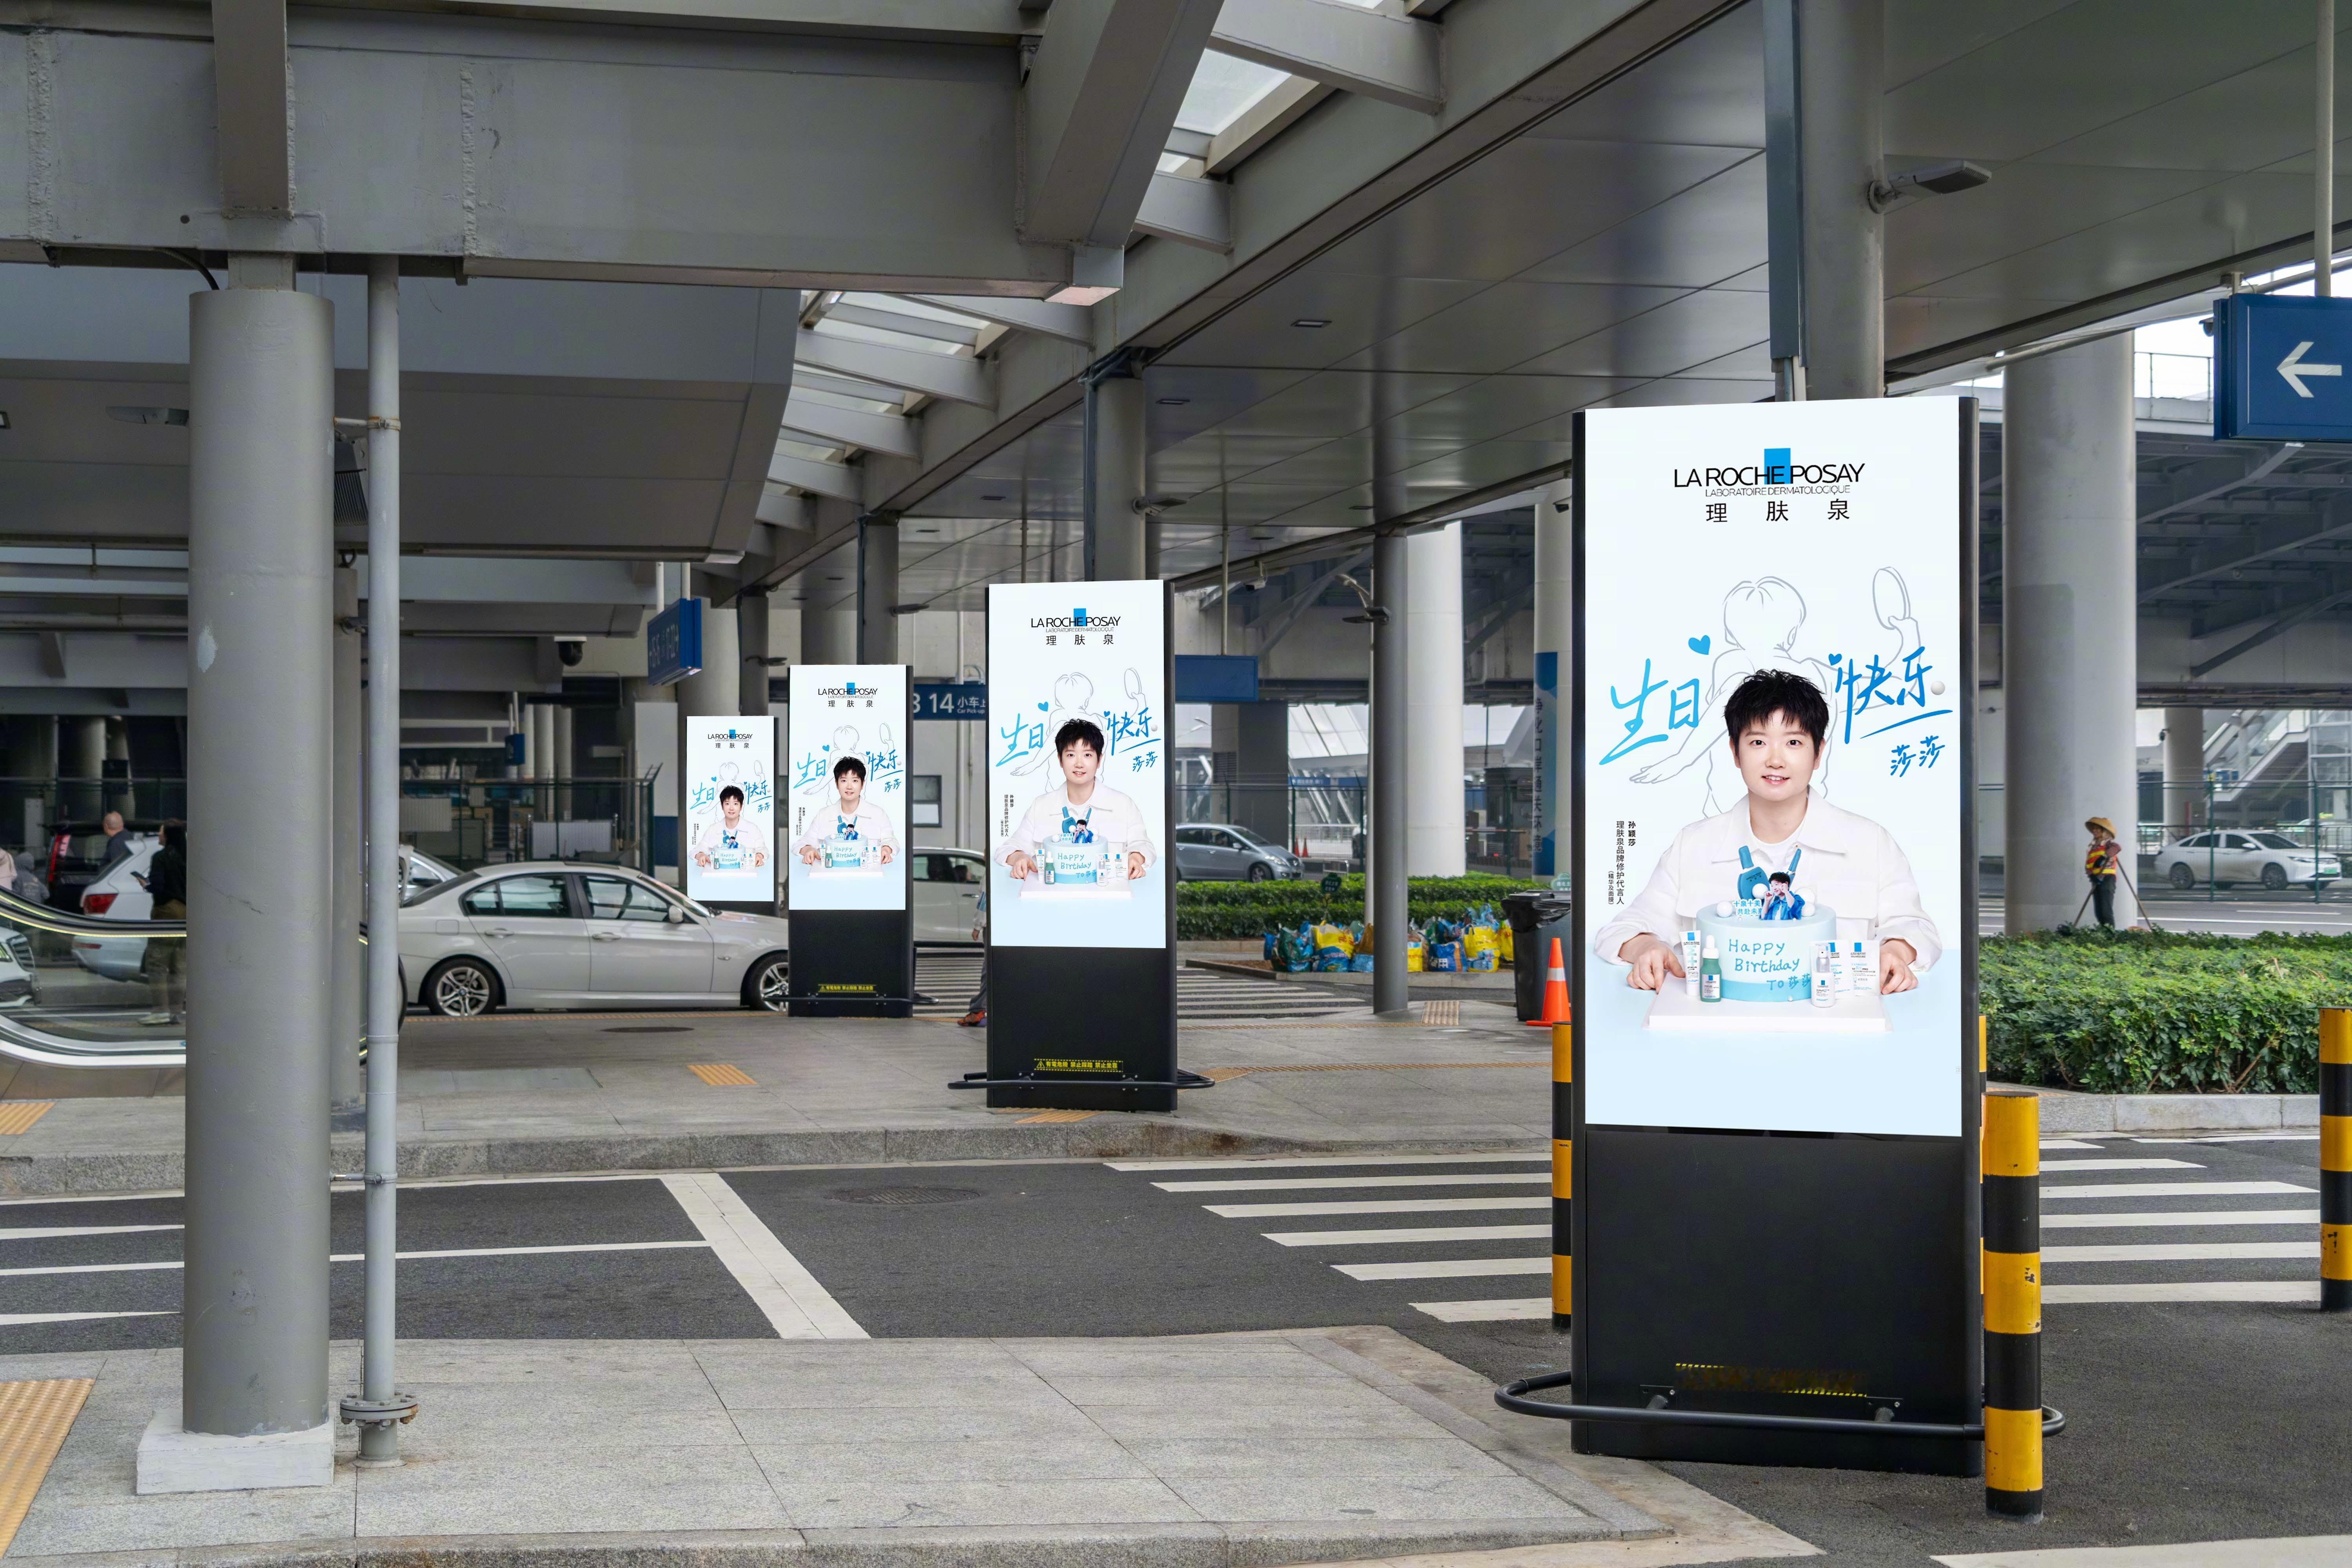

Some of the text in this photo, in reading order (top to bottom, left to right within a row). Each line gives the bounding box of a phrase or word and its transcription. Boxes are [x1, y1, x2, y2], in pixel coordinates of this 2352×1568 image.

[1674, 463, 1865, 488] LA ROCHE POSAY
[1705, 485, 1850, 497] LABORATOIRE DERMATOLOGIQUE
[1706, 498, 1850, 523] 理肤泉
[1031, 616, 1121, 628] LA ROCHE POSAY
[1046, 633, 1114, 646] 理肤泉
[929, 693, 955, 713] 14
[1599, 646, 1934, 766] 生日 快乐
[996, 707, 1153, 767] 生日 快乐
[793, 749, 898, 789] 生日 快乐
[690, 780, 768, 809] 生日 快乐
[1616, 821, 1625, 905] 理肤泉品牌修护代言人
[1728, 938, 1785, 956] Happy
[1735, 958, 1800, 973] Birthday
